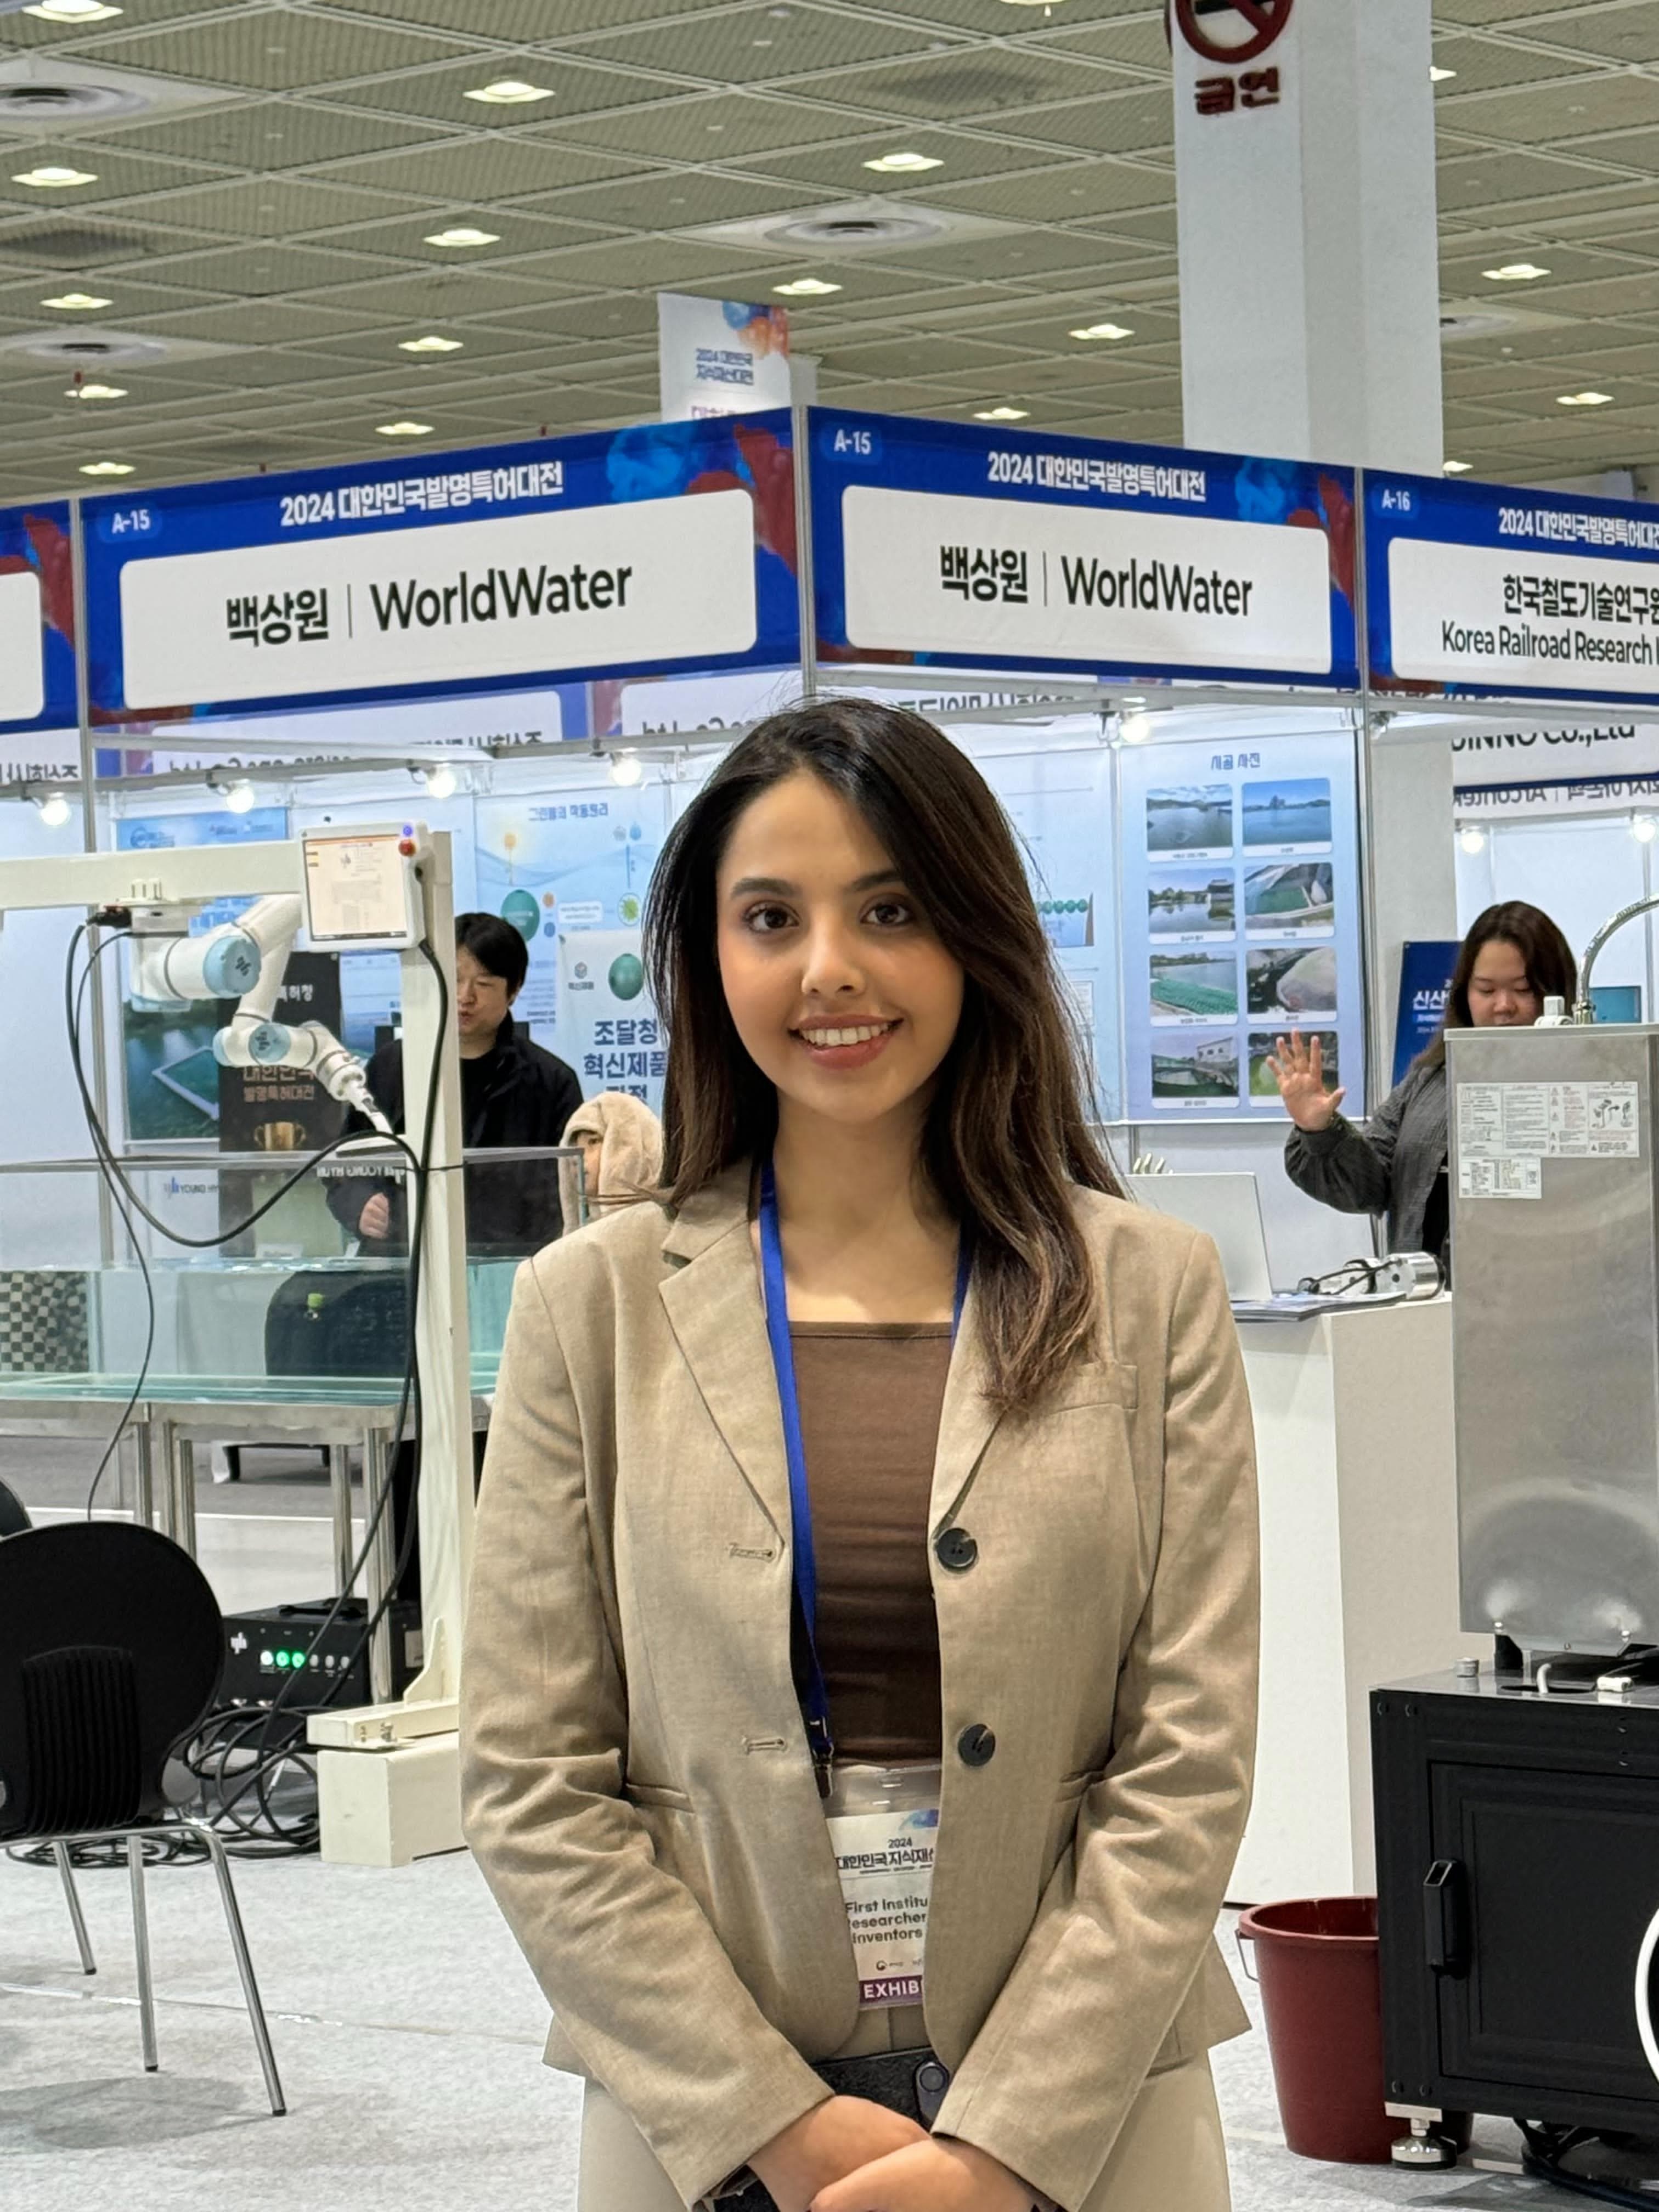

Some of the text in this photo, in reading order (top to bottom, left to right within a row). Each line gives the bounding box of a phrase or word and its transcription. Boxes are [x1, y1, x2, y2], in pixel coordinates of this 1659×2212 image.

[1194, 66, 1280, 115] 금연
[836, 432, 870, 454] A-15
[989, 452, 1206, 503] 2024 대한민국발명특허대전
[280, 461, 564, 526] 2024 대한민국발명특허대전
[1382, 490, 1410, 511] A-16
[112, 509, 150, 533] A-15
[1499, 507, 1533, 535] 2024
[941, 546, 1252, 616] 백상원 WorldWater
[227, 565, 632, 646] 백상원 WorldWater
[1442, 620, 1495, 654] Korea
[1499, 623, 1571, 659] Railroad
[1575, 630, 1652, 665] Research
[594, 1018, 658, 1046] 조달청
[888, 1837, 913, 1849] 2024
[845, 1900, 878, 1914] First
